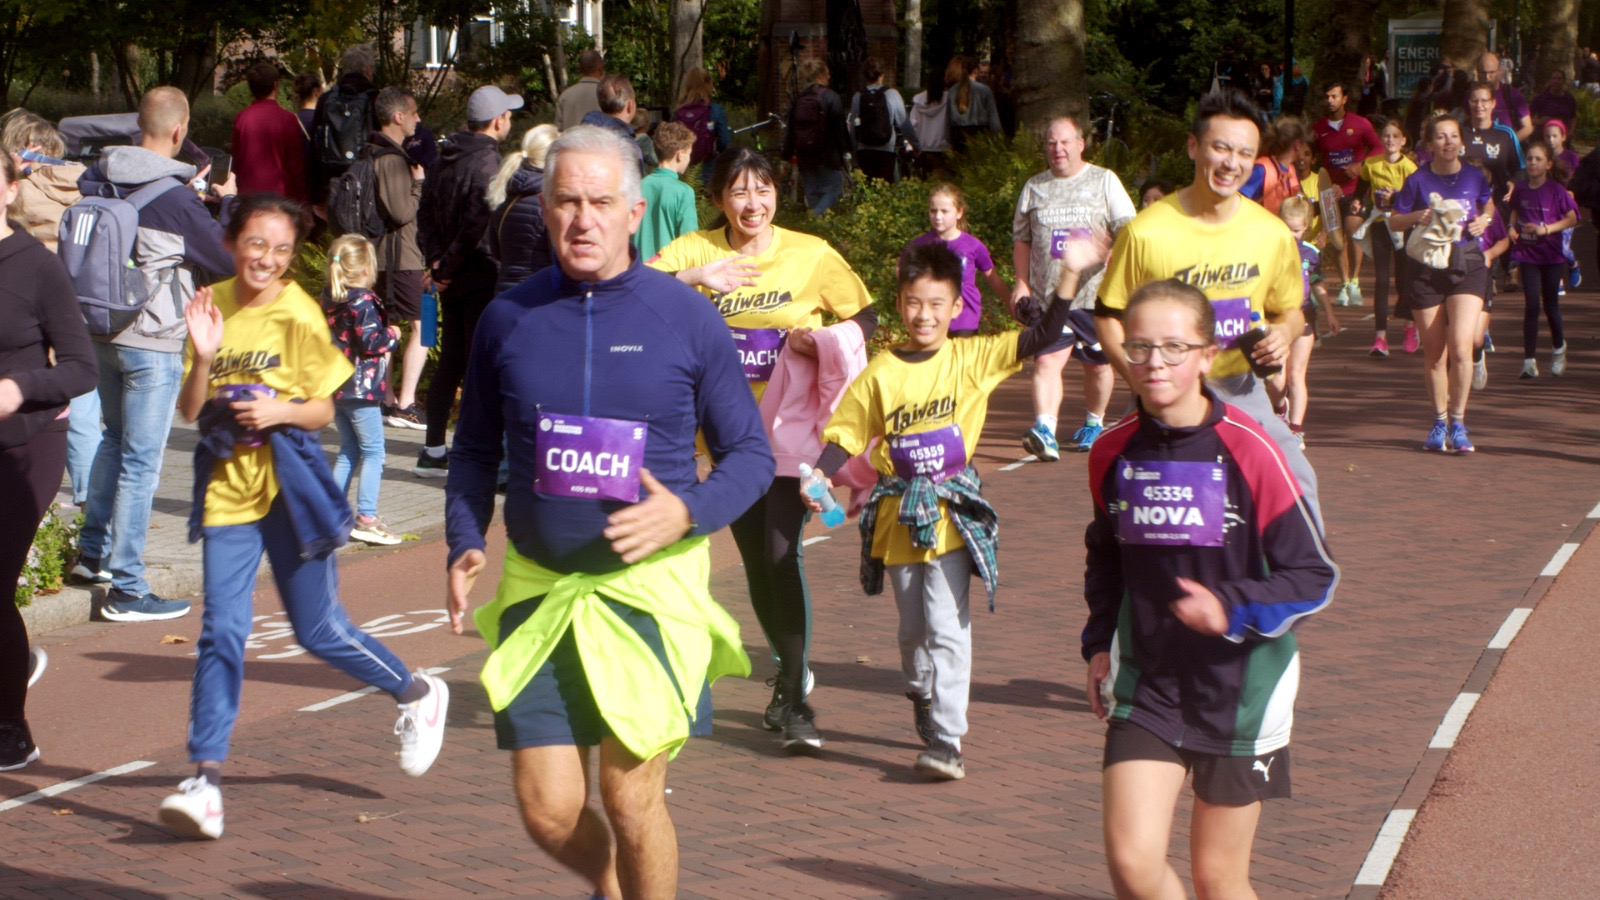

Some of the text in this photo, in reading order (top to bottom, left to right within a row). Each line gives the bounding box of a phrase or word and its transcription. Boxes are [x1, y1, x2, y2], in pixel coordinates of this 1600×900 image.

[1398, 61, 1431, 73] HUIS
[1214, 317, 1244, 337] ACH
[213, 350, 269, 374] aiwan
[909, 443, 945, 460] 45359
[546, 447, 630, 478] COACH
[1143, 486, 1194, 502] 45334
[1133, 506, 1205, 526] NOVA
